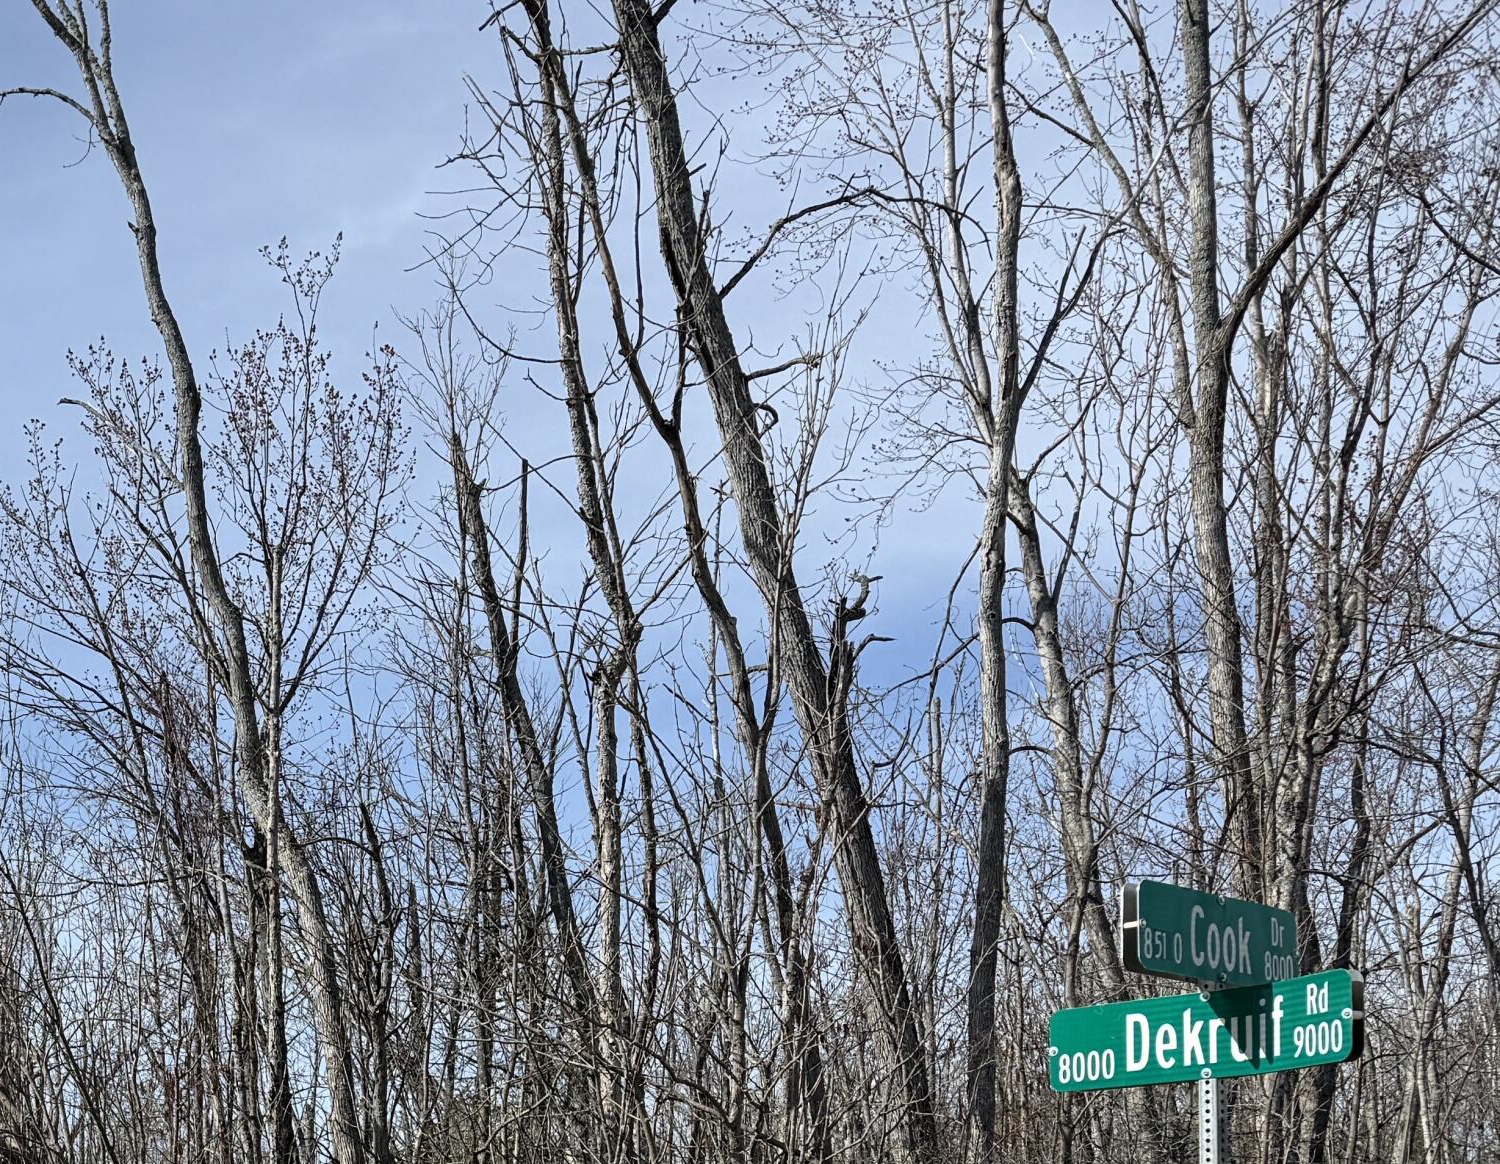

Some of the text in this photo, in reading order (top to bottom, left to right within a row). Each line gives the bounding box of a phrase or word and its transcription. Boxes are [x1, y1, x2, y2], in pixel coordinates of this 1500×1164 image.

[1191, 905, 1252, 975] Cook
[1271, 917, 1285, 948] Dr
[1264, 951, 1294, 981] 8000
[1058, 981, 1330, 1084] 8000 Dekruif Rd
[1293, 1019, 1343, 1058] 9000
